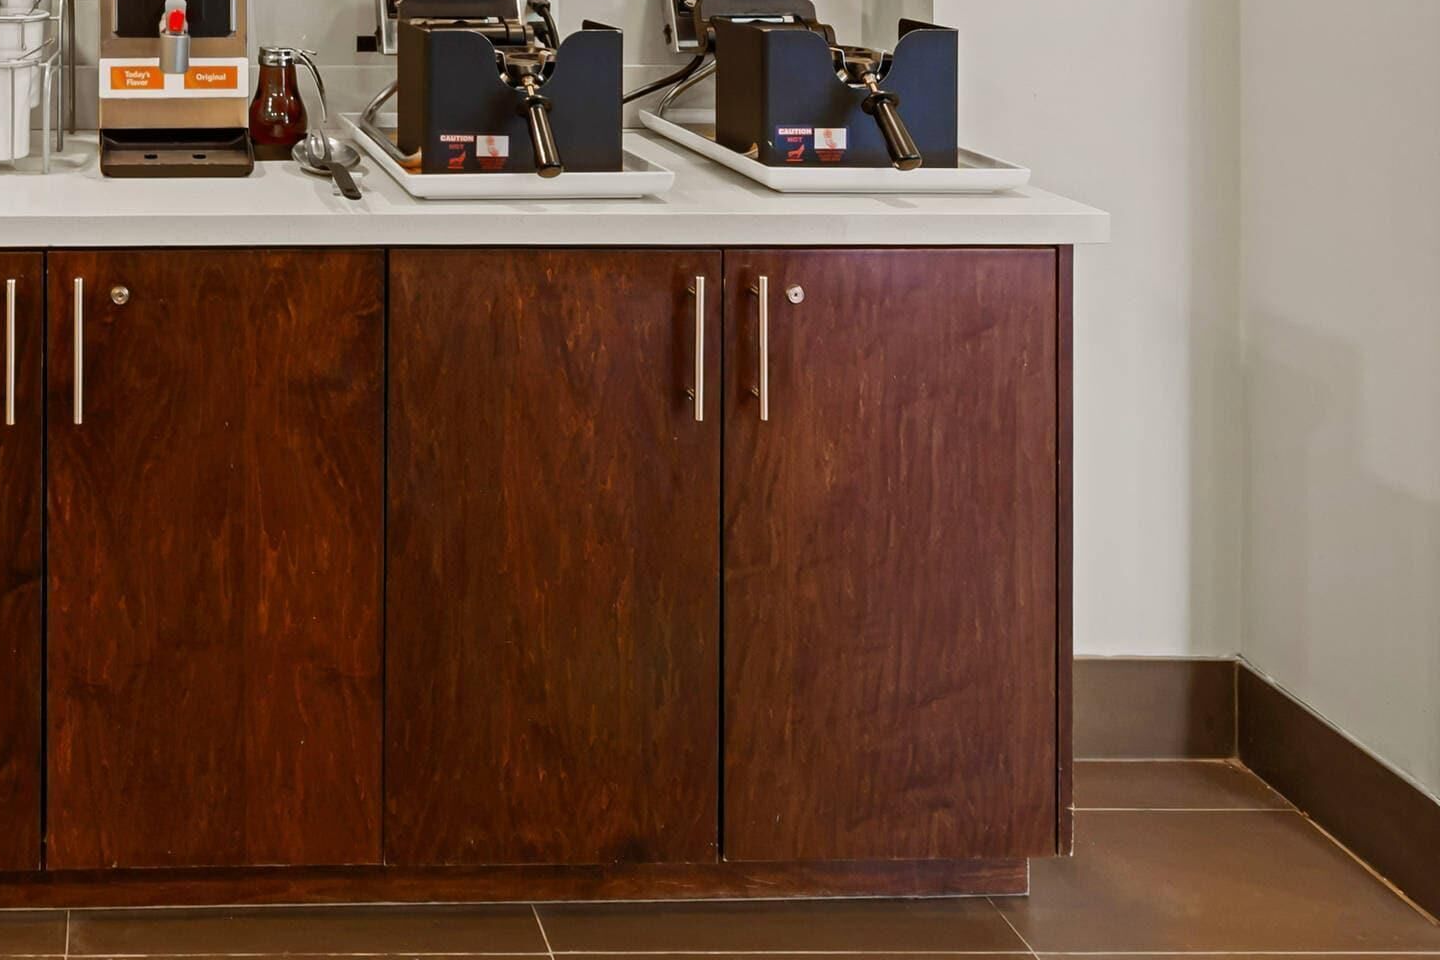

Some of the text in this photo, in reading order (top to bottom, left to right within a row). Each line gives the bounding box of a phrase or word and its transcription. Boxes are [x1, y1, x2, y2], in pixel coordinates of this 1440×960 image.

[124, 70, 151, 79] Today's
[195, 73, 227, 82] Original
[126, 78, 149, 86] Flavor
[440, 134, 474, 142] CAUTION
